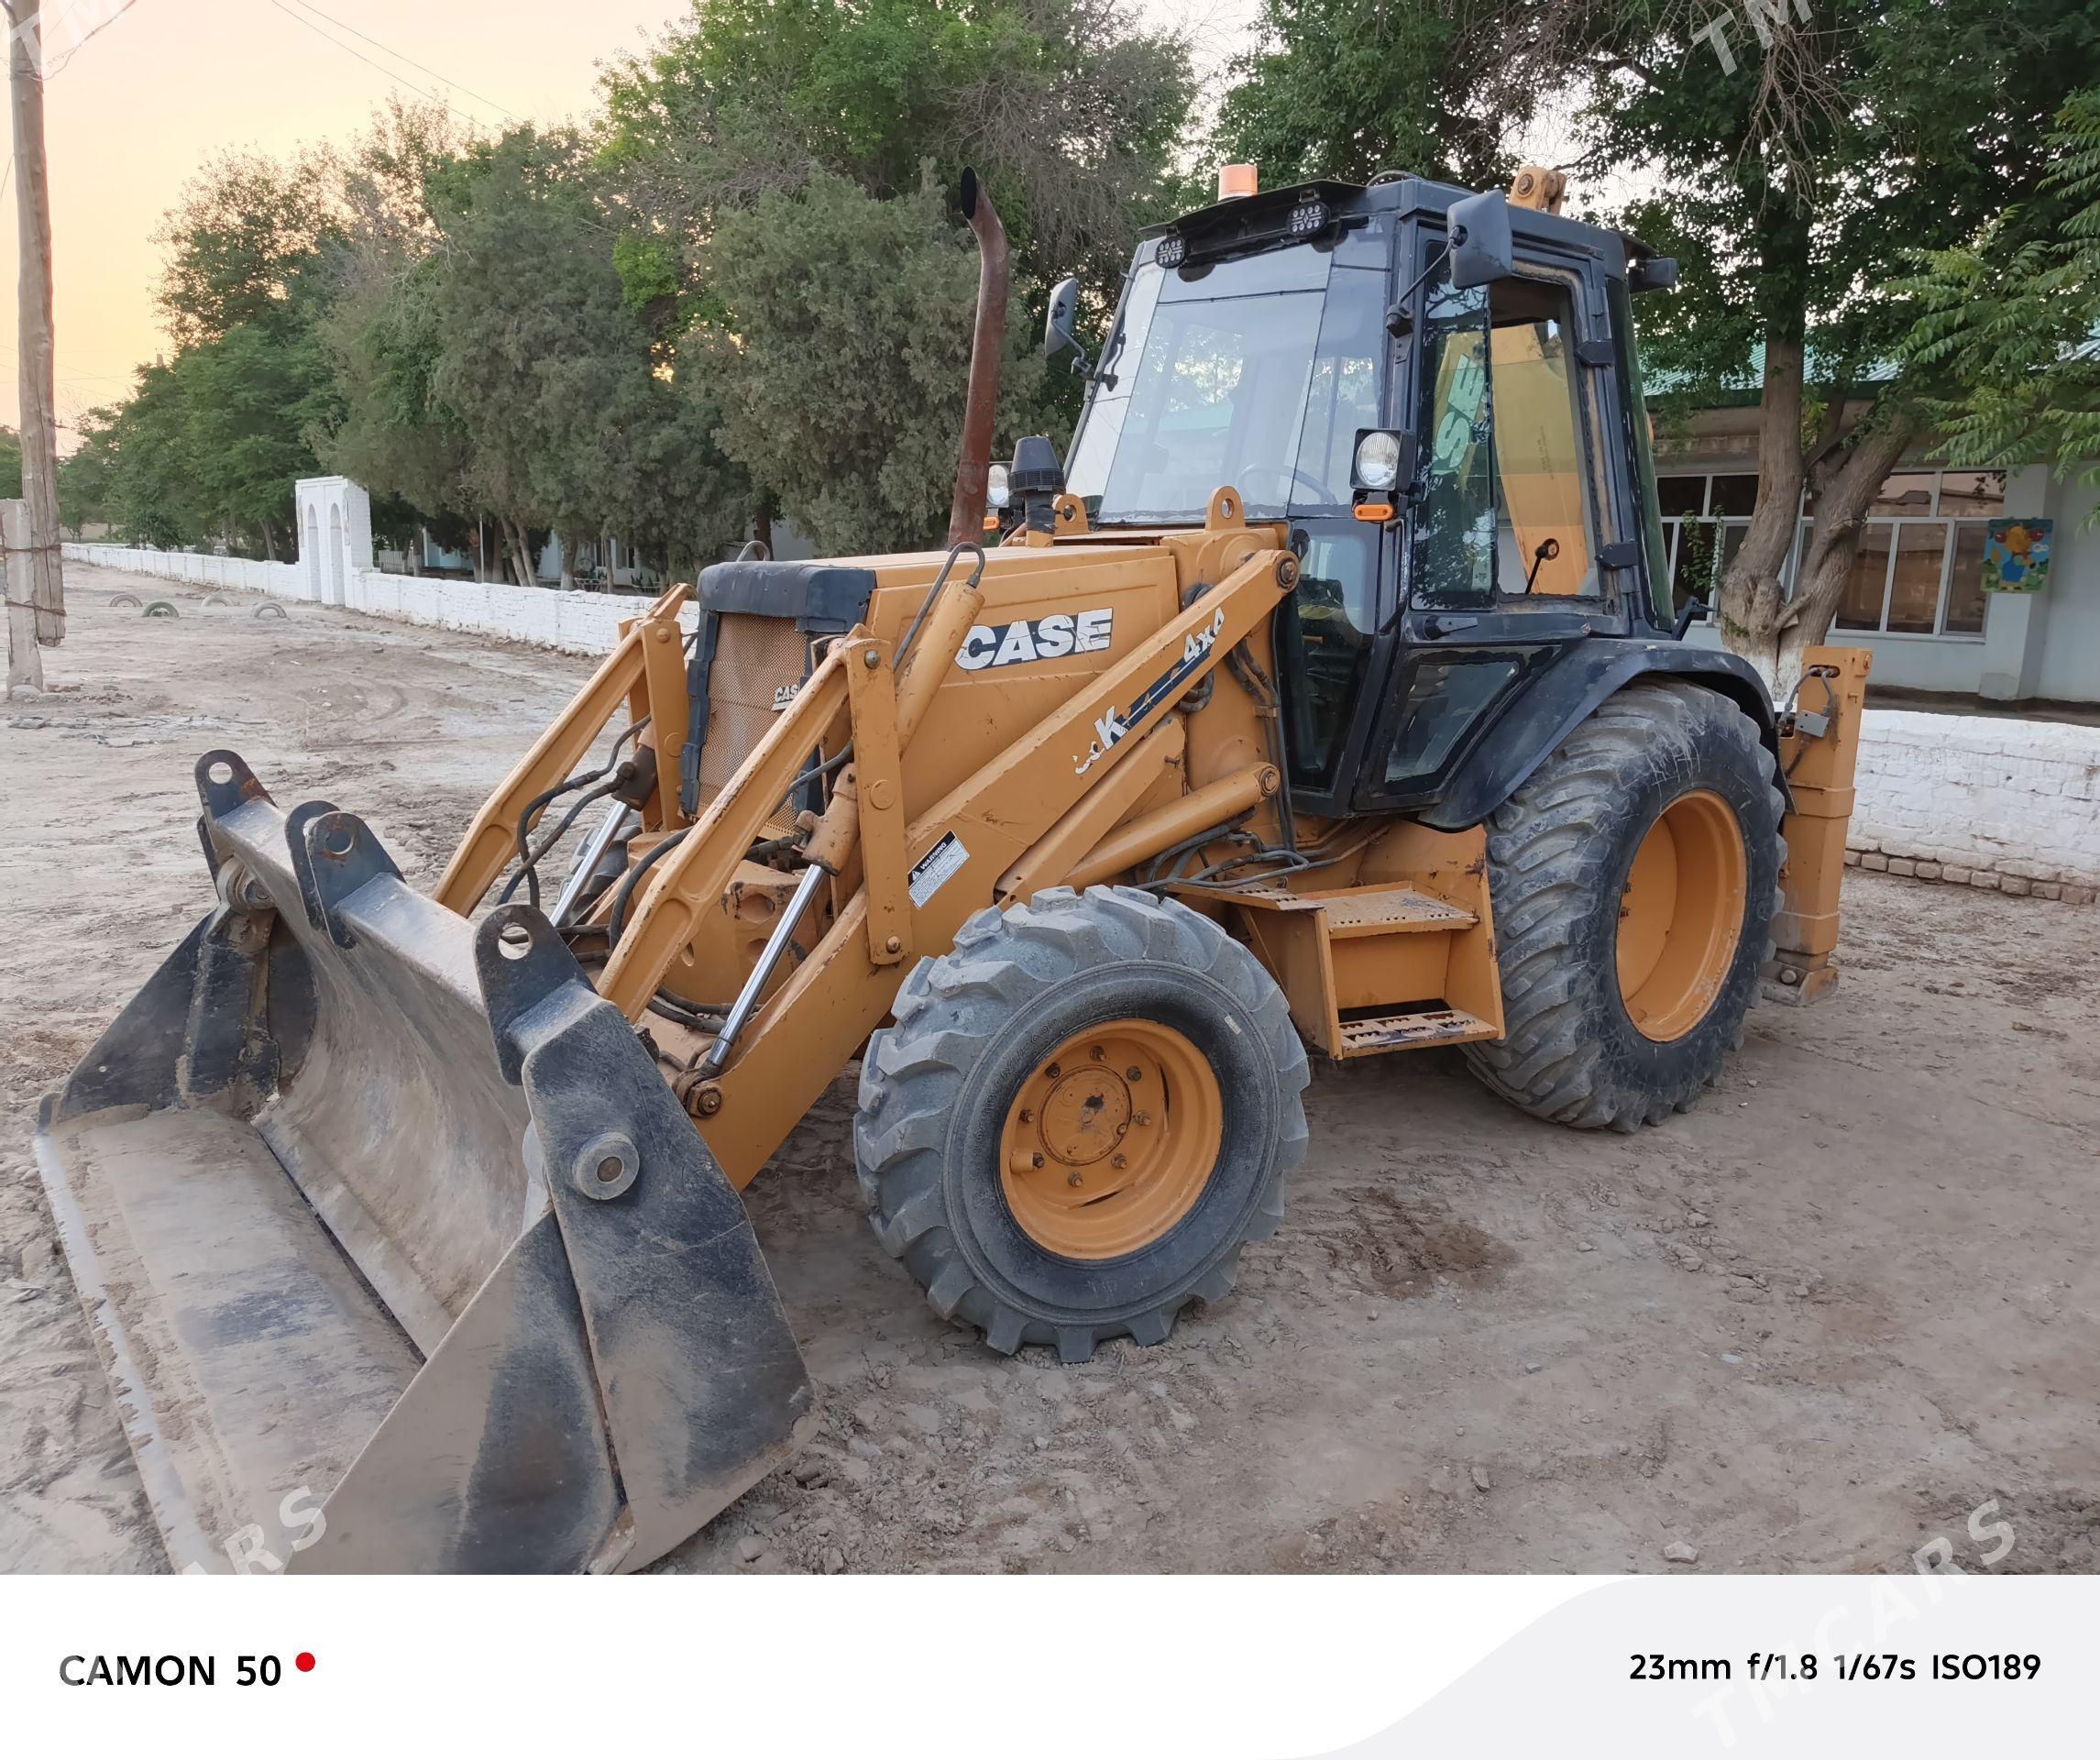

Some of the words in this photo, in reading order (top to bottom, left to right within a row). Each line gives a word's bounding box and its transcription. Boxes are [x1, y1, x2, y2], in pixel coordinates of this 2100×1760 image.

[1431, 353, 1485, 476] SE
[954, 608, 1113, 670] CASE
[774, 684, 798, 703] CAS
[919, 842, 947, 870] WARNING
